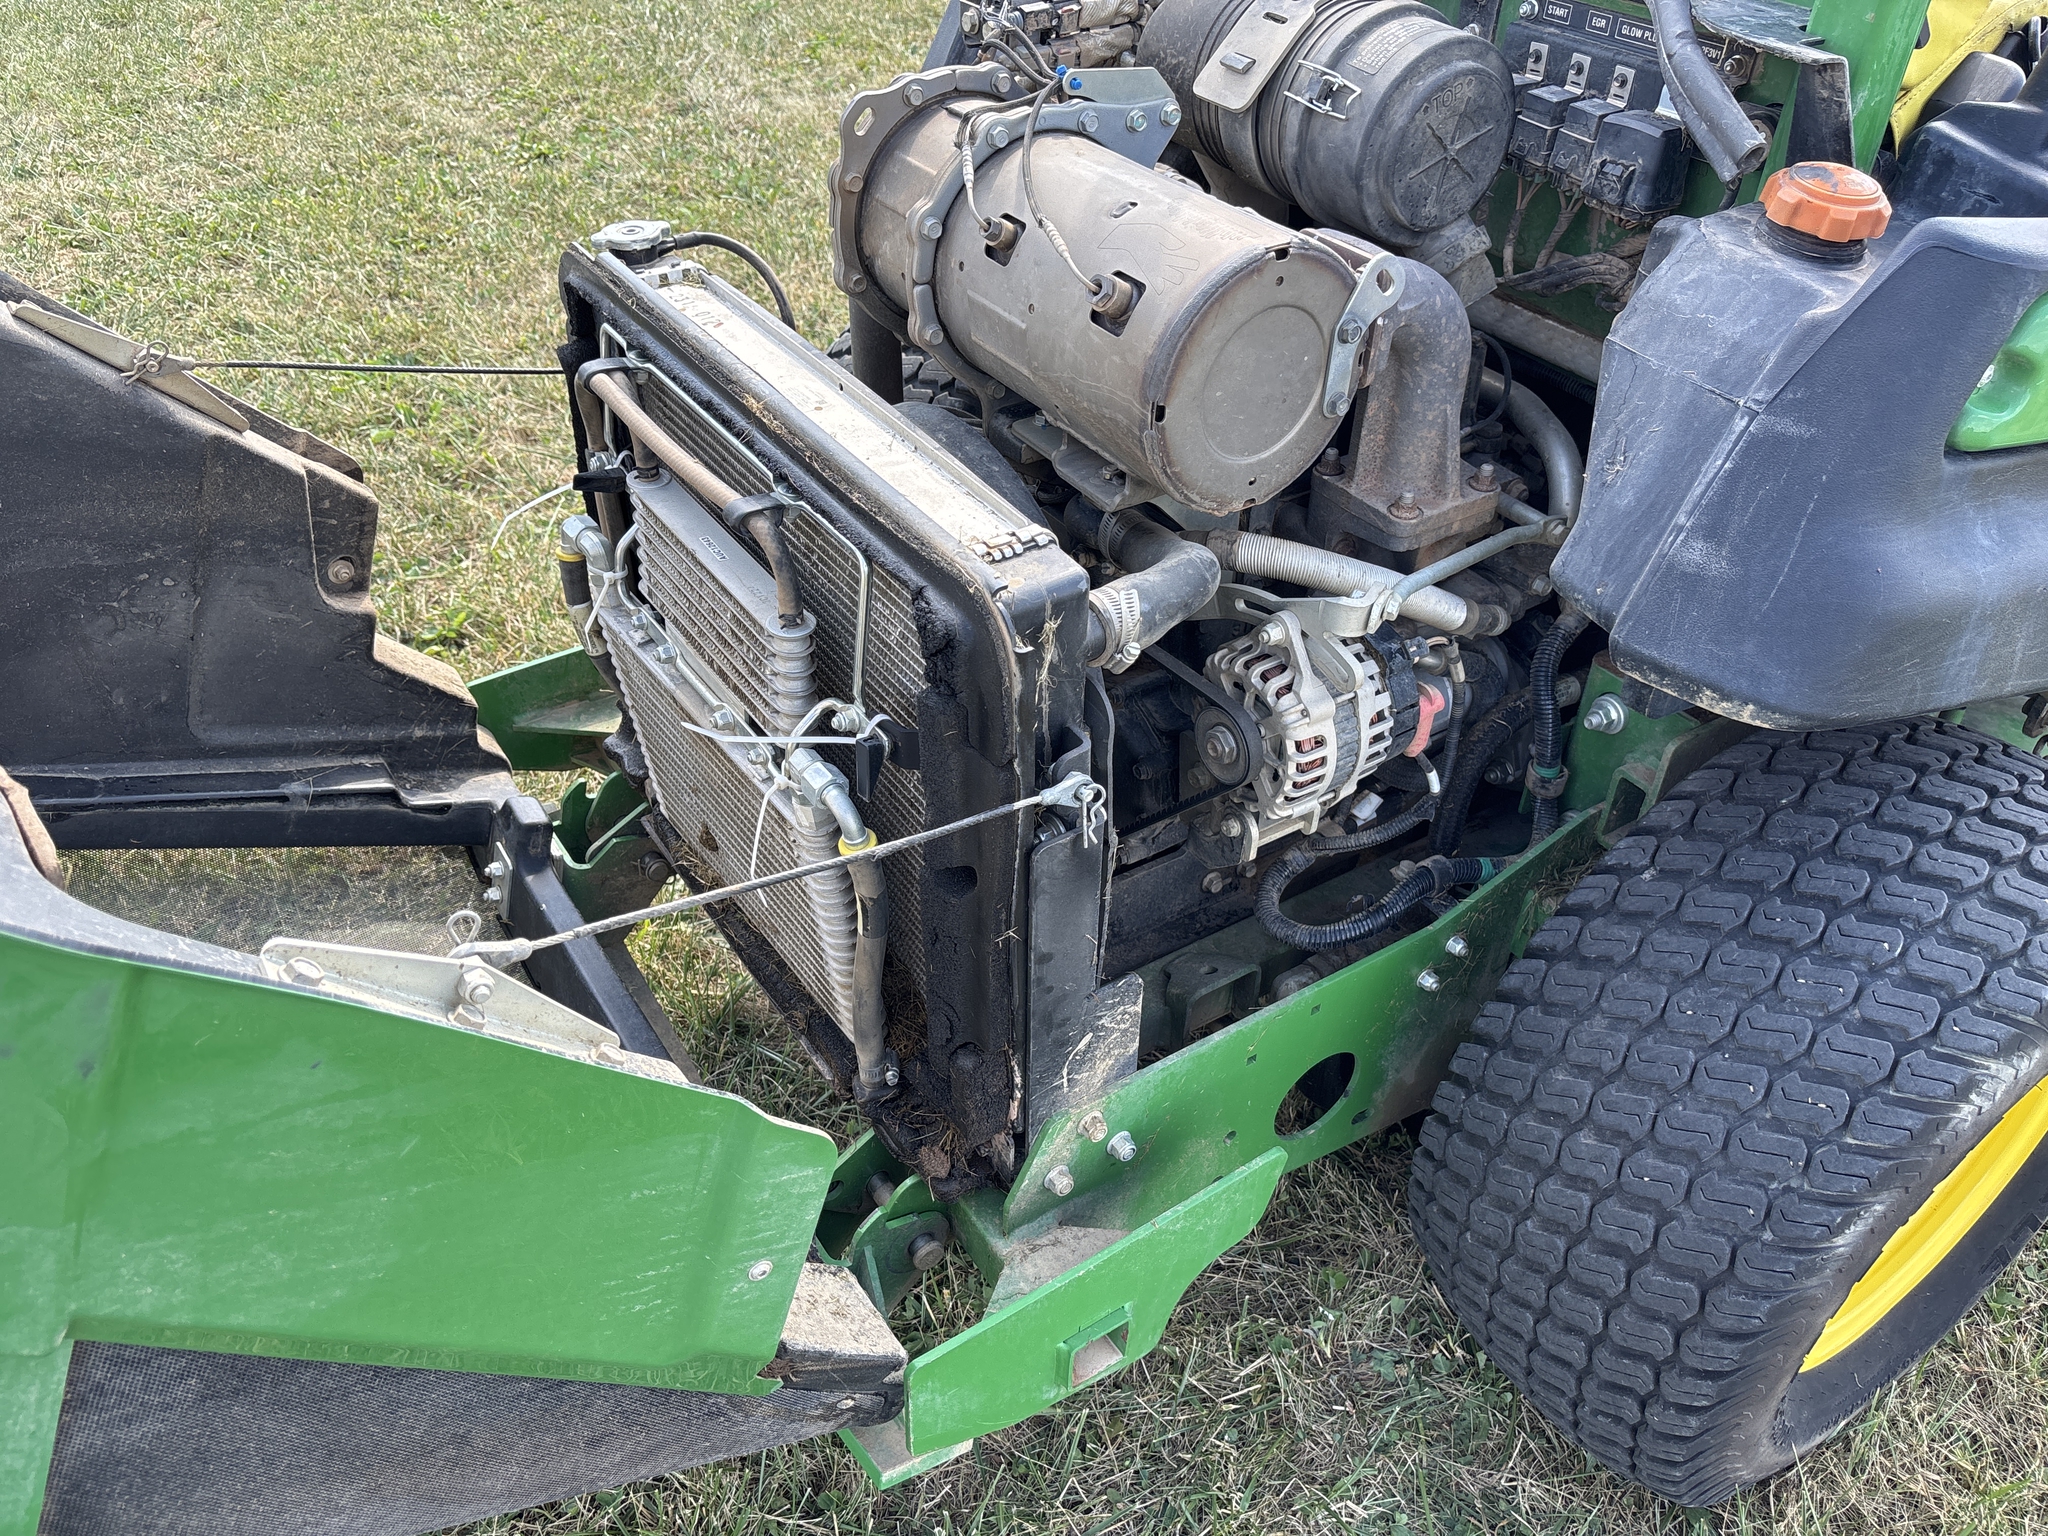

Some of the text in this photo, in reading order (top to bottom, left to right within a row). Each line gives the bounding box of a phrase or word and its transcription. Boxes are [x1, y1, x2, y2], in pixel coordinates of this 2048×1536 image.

[1547, 5, 1569, 19] START
[1591, 16, 1606, 29] EGR
[1621, 25, 1657, 43] GLOW PLU
[1366, 44, 1388, 65] Service
[1371, 43, 1383, 54] not
[1371, 50, 1388, 66] when
[1431, 82, 1463, 113] TOP
